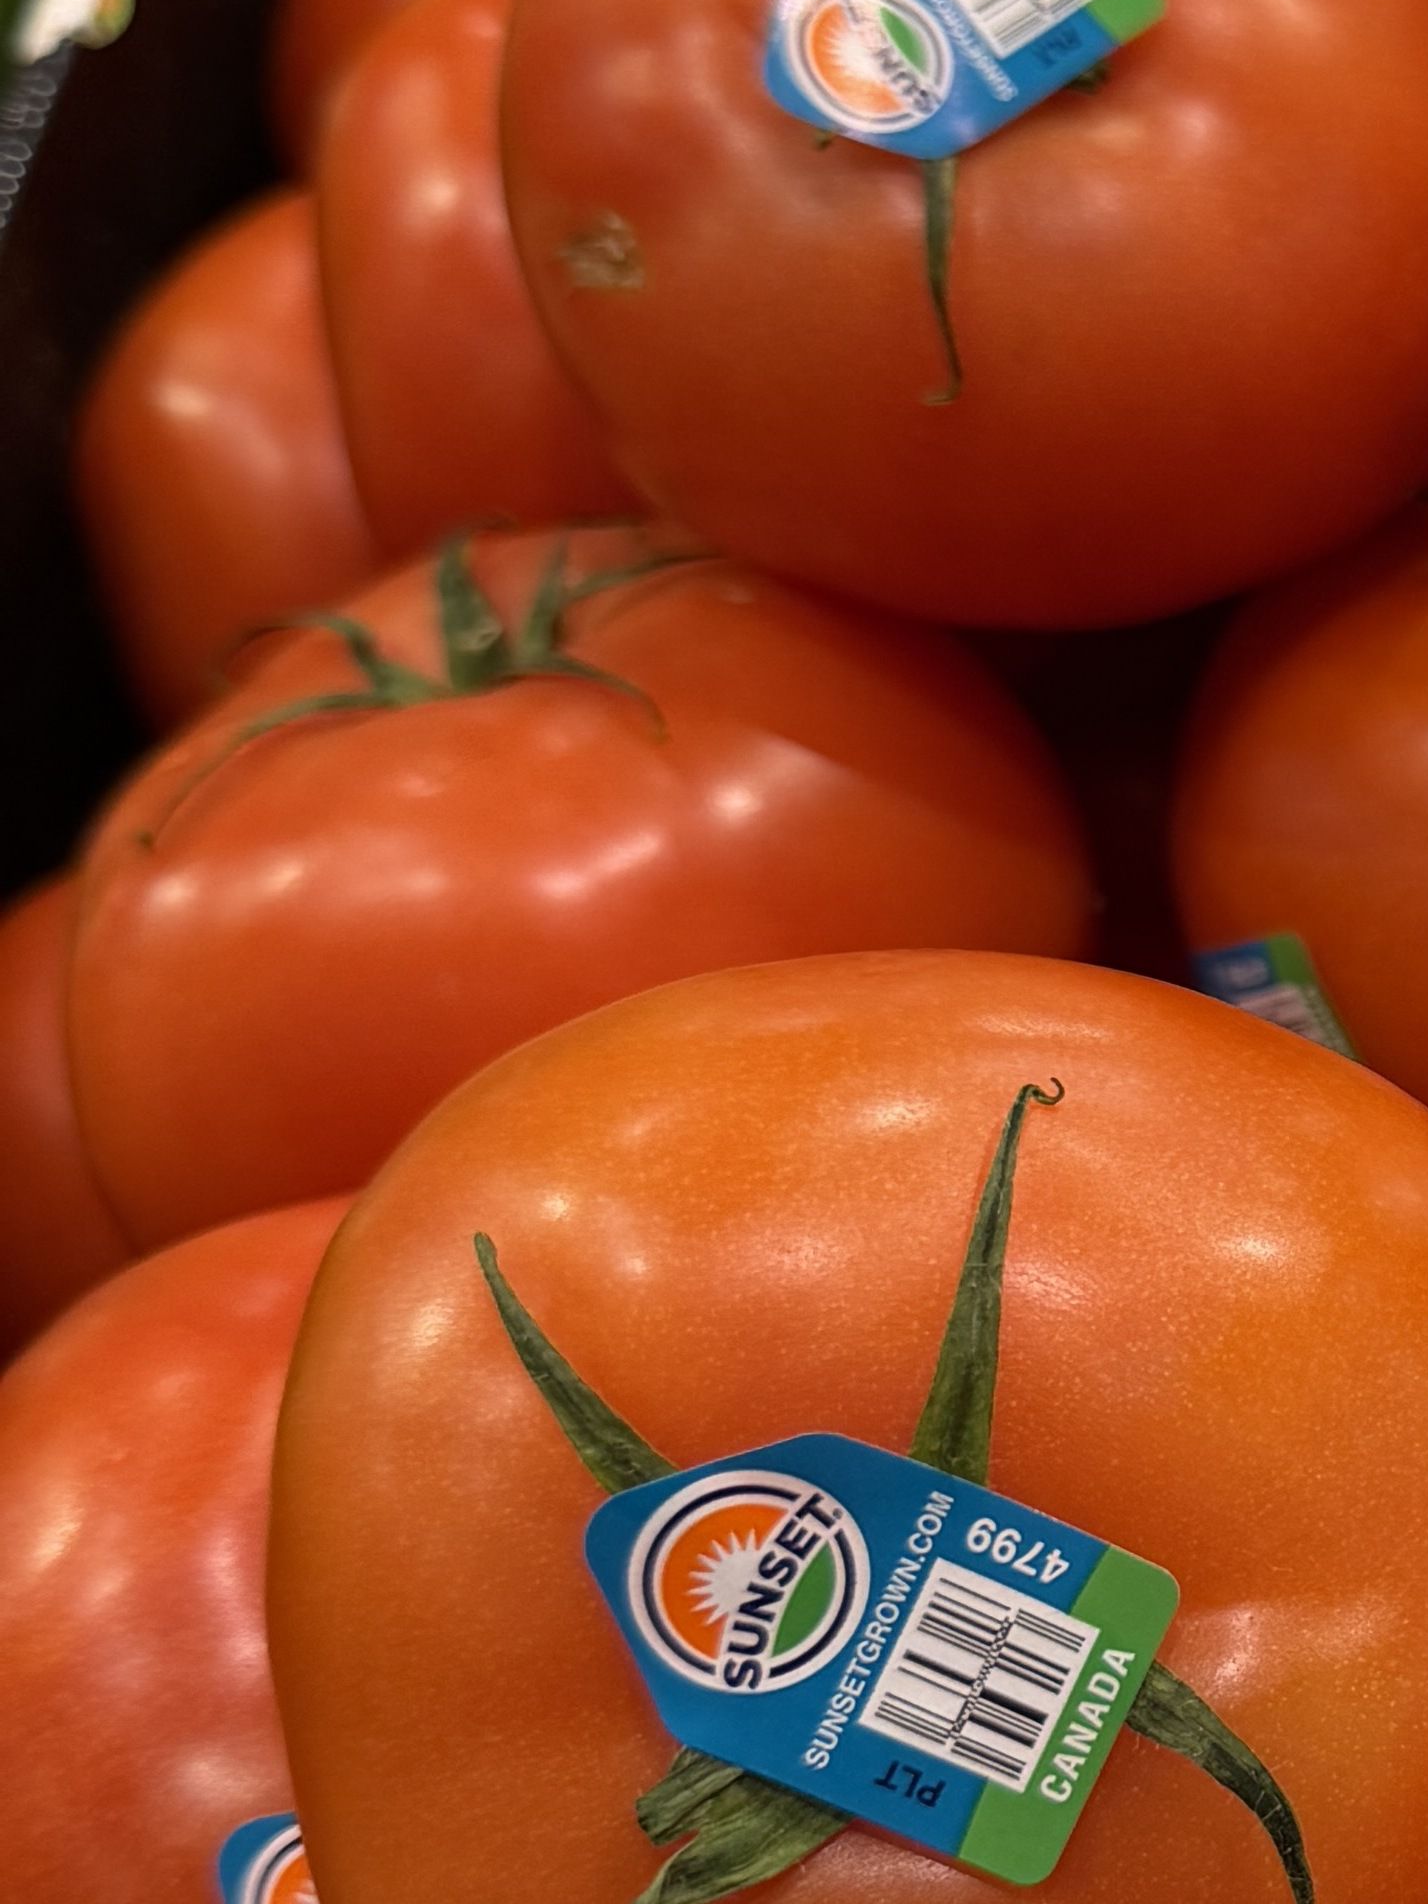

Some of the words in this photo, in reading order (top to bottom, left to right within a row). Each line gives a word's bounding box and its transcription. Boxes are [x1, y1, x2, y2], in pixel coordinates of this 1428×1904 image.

[724, 1492, 838, 1690] SUNSET
[965, 1517, 1070, 1585] 4799
[804, 1490, 954, 1771] SUNSETGROWN.COM
[874, 1759, 947, 1807] PLT
[1040, 1646, 1135, 1803] CANADA
